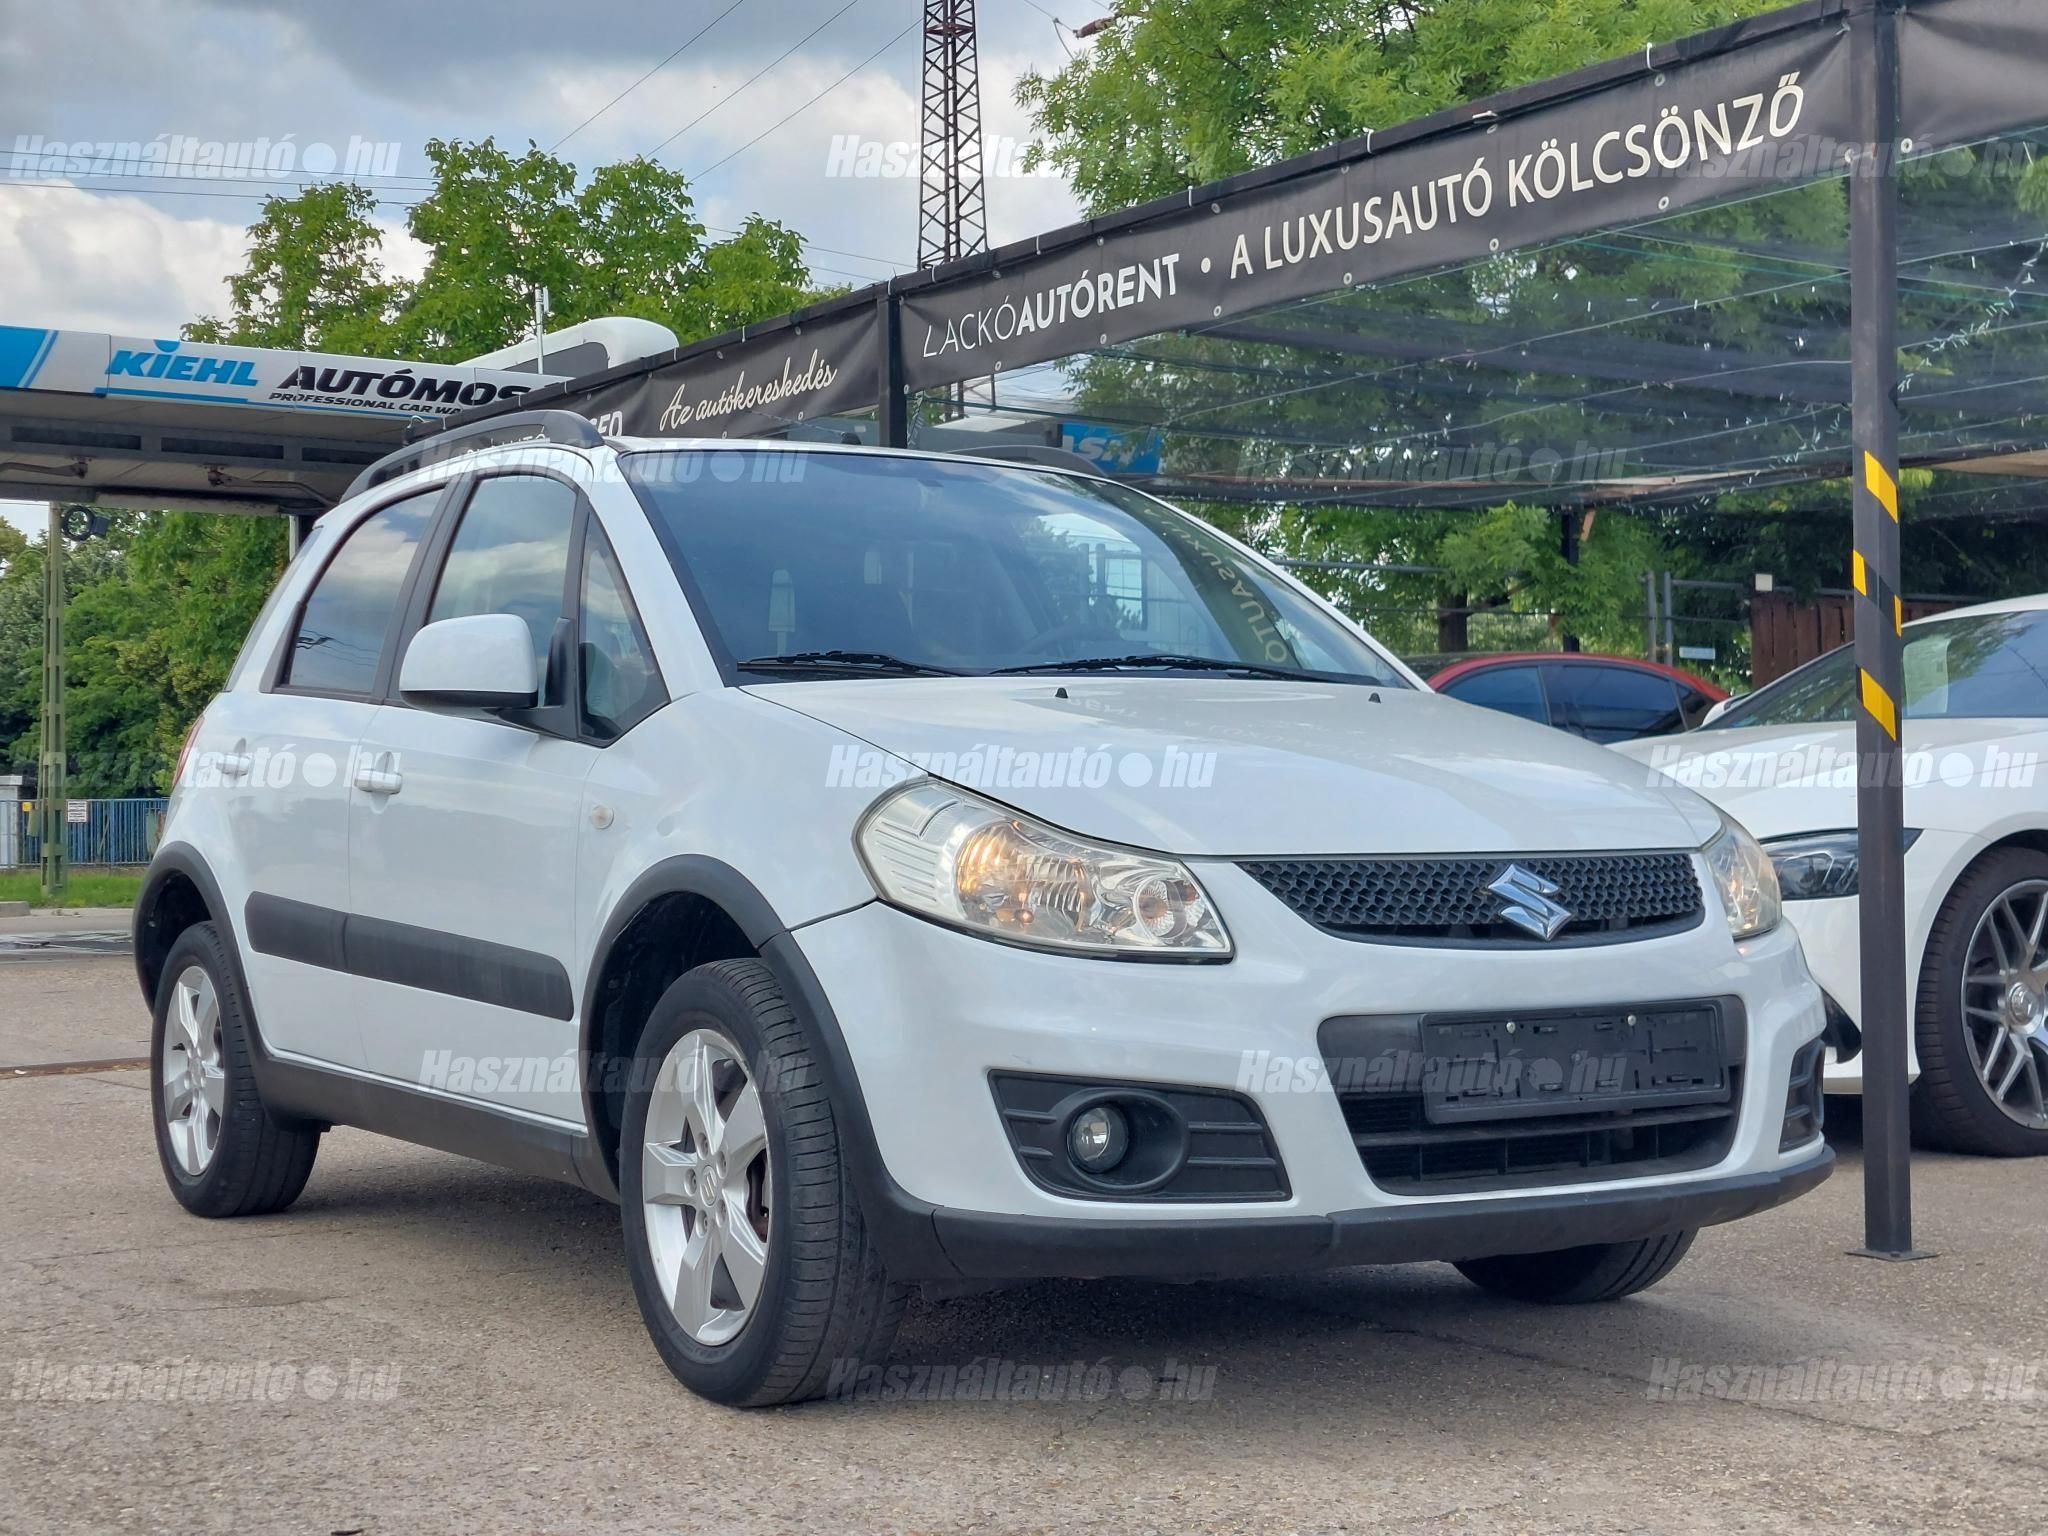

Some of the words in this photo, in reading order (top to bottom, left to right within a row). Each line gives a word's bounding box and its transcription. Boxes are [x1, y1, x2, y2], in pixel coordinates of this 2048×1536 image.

[923, 253, 1179, 358] LACKÓAUTÓRENT
[1230, 234, 1254, 279] A
[1263, 157, 1493, 270] LUXUSAUTÓ
[1508, 71, 1804, 208] KÖLCSÖNZŐ
[105, 339, 259, 386] KIEHL
[659, 383, 695, 431] Az
[696, 348, 838, 420] autókereskedés
[268, 392, 395, 411] PROFESSIONAL
[398, 403, 435, 415] CAR
